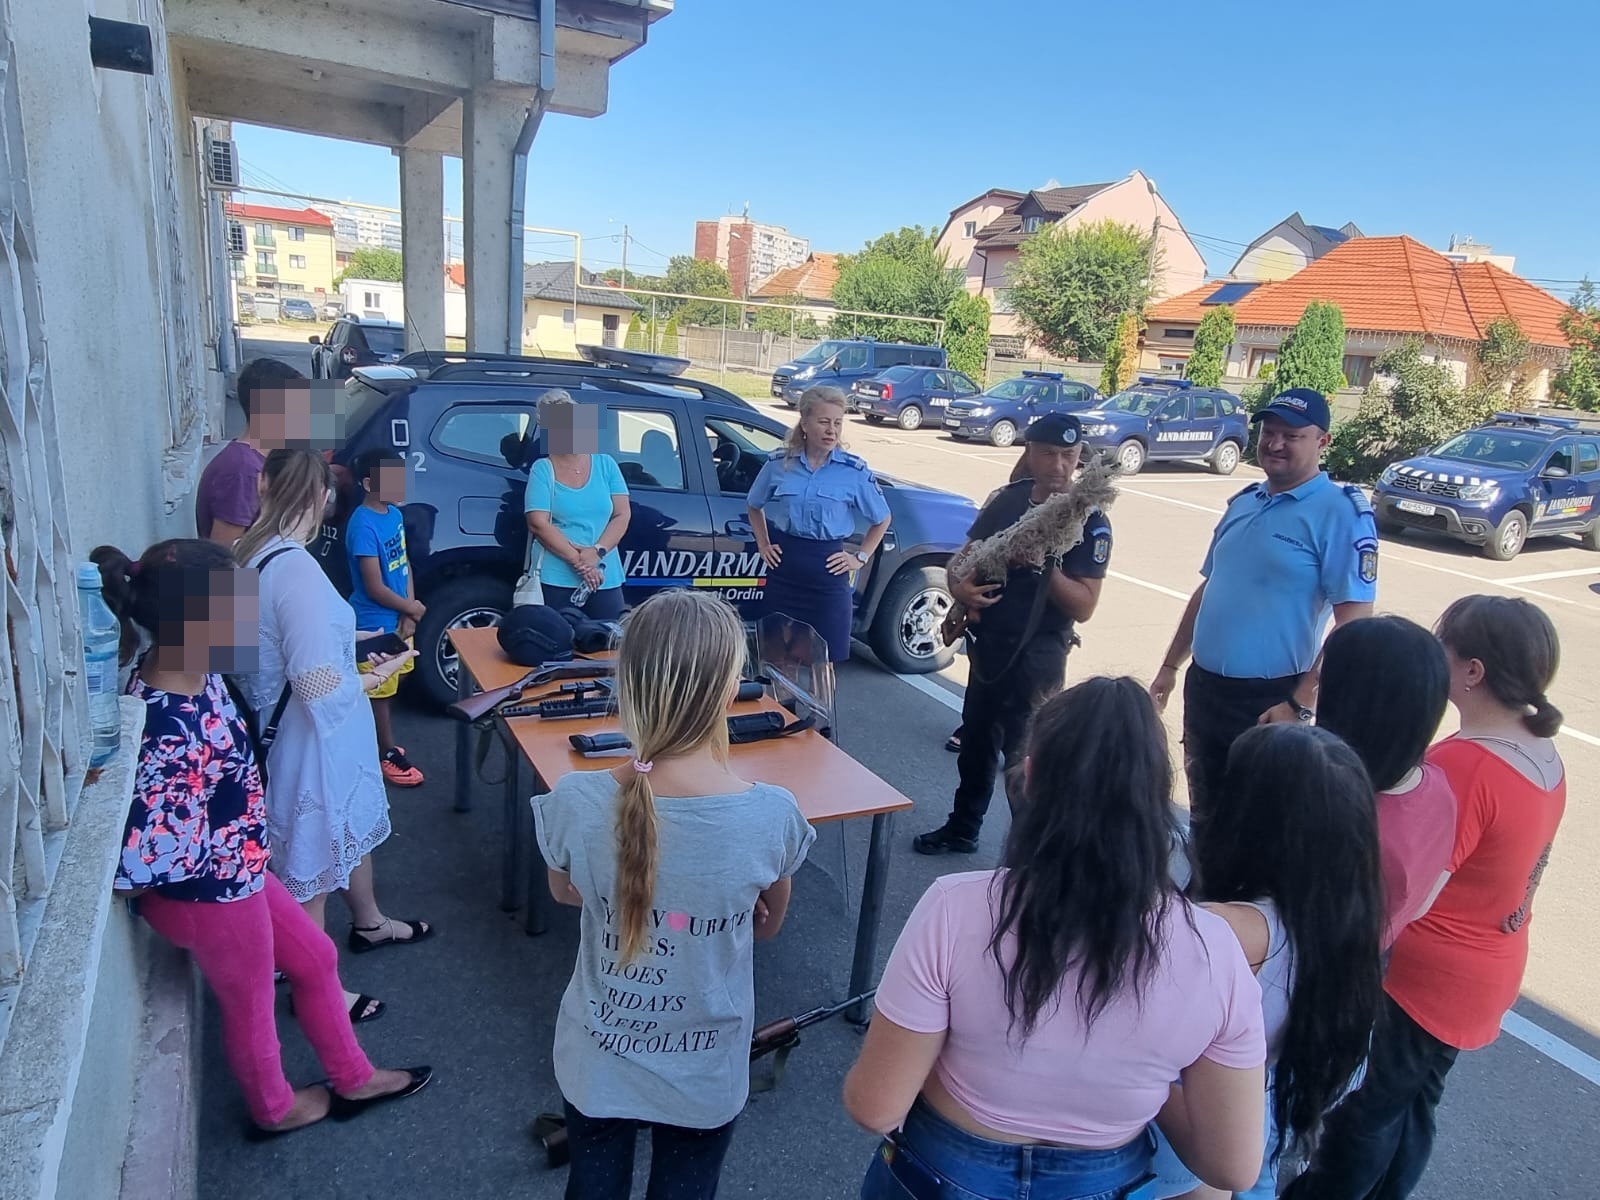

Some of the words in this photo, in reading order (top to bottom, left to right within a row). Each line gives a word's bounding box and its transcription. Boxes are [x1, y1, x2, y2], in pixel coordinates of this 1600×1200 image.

[1156, 431, 1213, 442] JANDARMERIA
[322, 524, 338, 540] 112
[726, 588, 764, 600] Ordin
[602, 980, 687, 1013] RIDAYS
